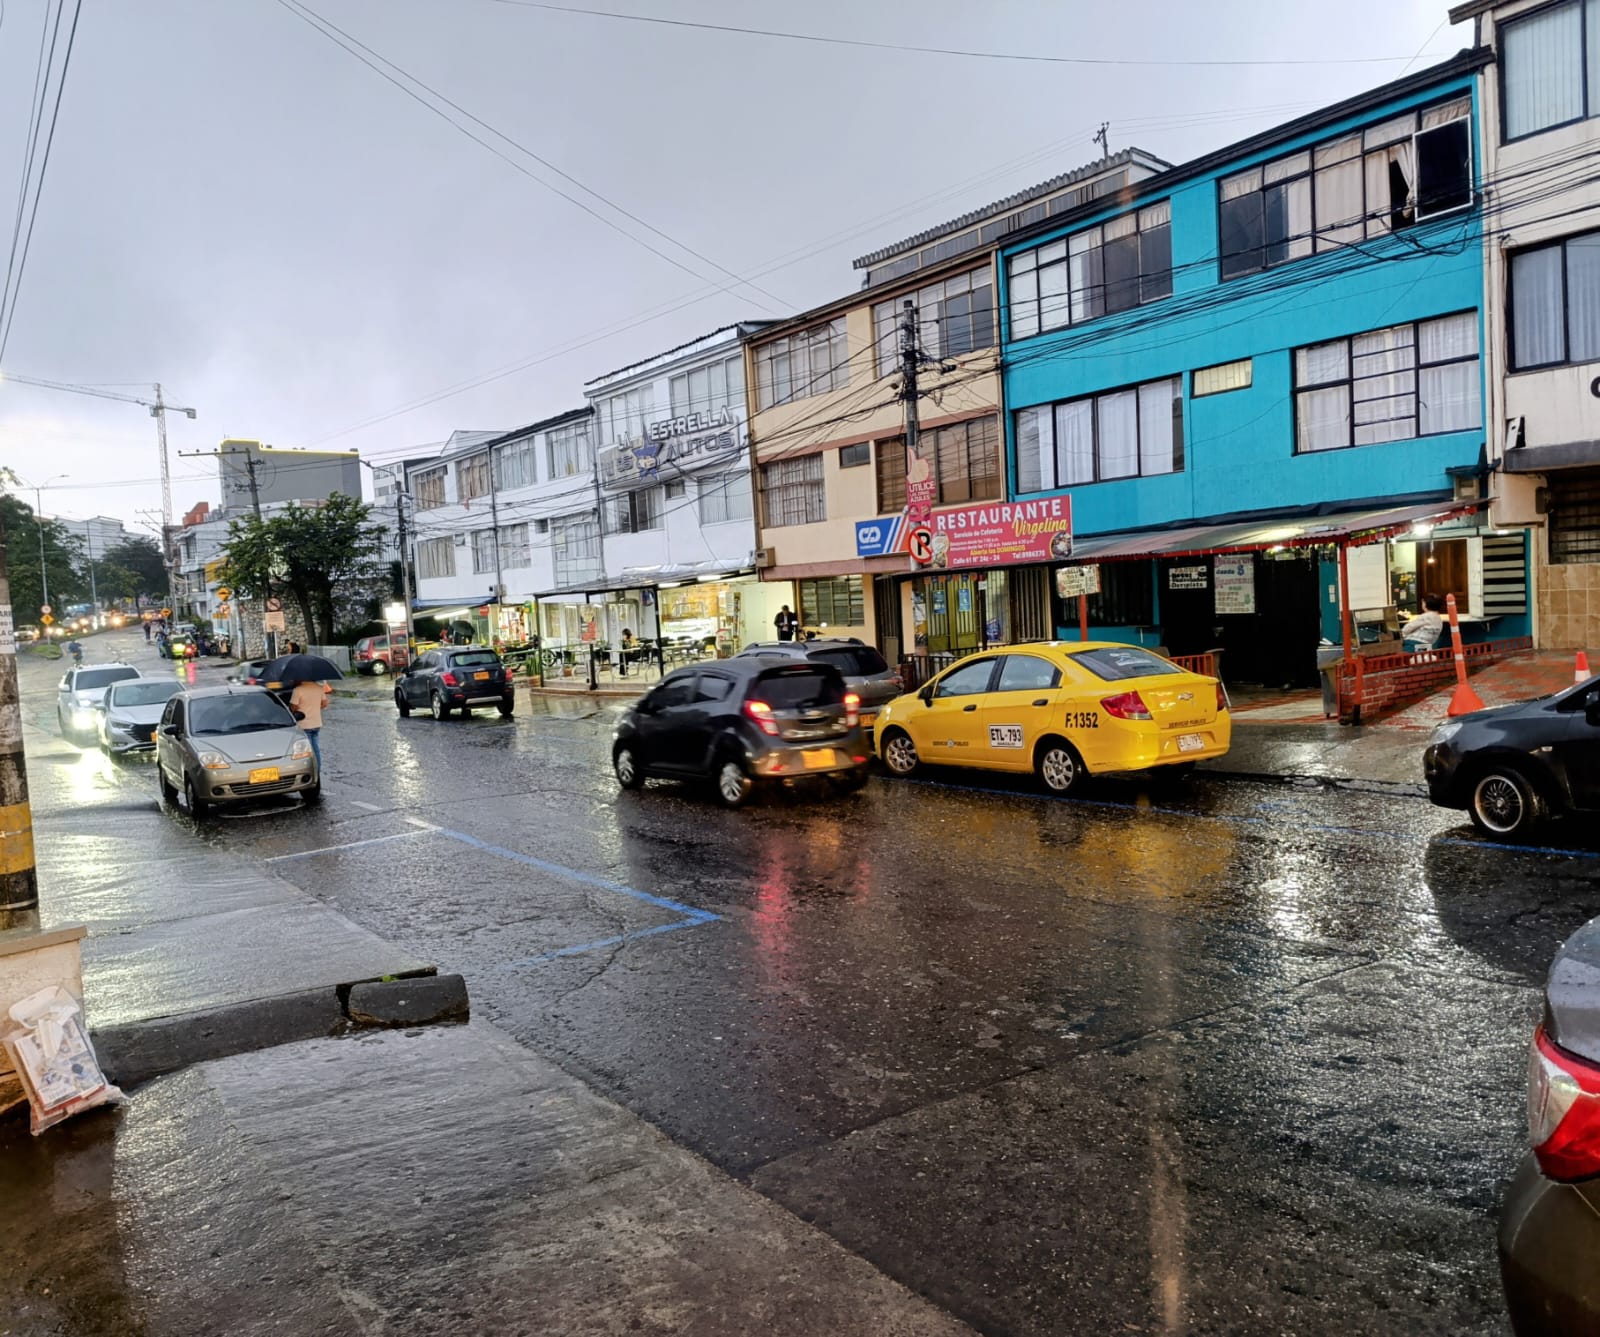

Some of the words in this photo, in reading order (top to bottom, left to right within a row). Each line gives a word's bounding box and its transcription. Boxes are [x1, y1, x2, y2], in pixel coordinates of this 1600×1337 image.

[651, 404, 731, 441] ESTRELLA
[666, 432, 735, 460] AUTOS
[909, 481, 936, 492] UTILICE
[937, 499, 1062, 530] RESTAURANTE
[1012, 517, 1069, 539] Virgelina
[1065, 712, 1099, 728] F.1352
[990, 728, 1022, 742] ETL-793
